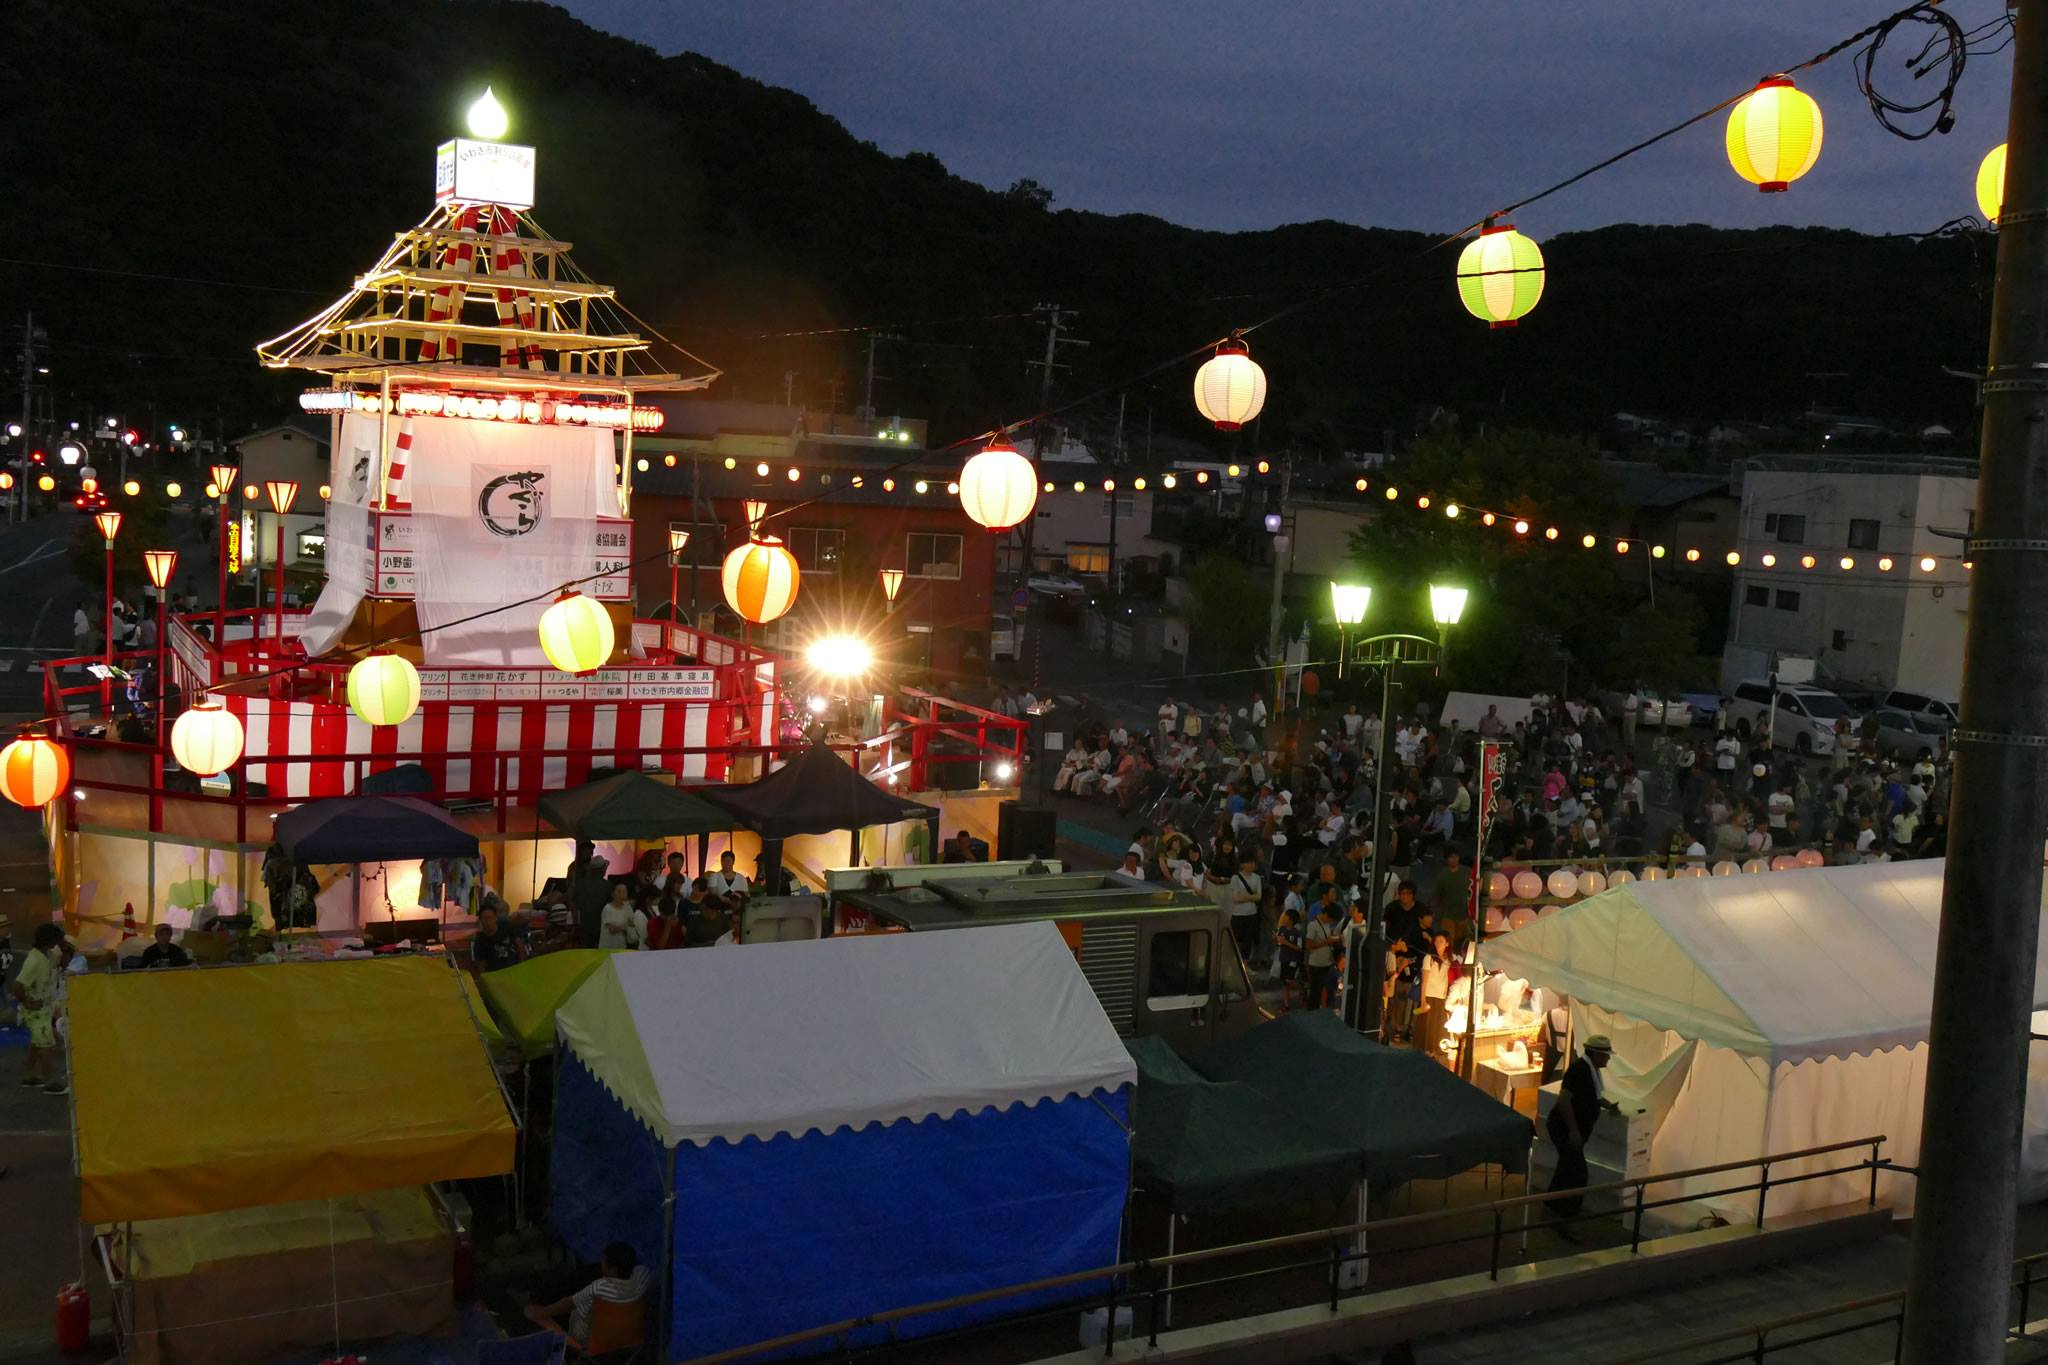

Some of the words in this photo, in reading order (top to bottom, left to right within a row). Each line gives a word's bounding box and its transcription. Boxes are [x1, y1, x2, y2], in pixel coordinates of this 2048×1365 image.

[383, 556, 414, 568] 小野歯
[419, 672, 447, 681] アリング
[633, 687, 709, 696] いわき市内郷金融団
